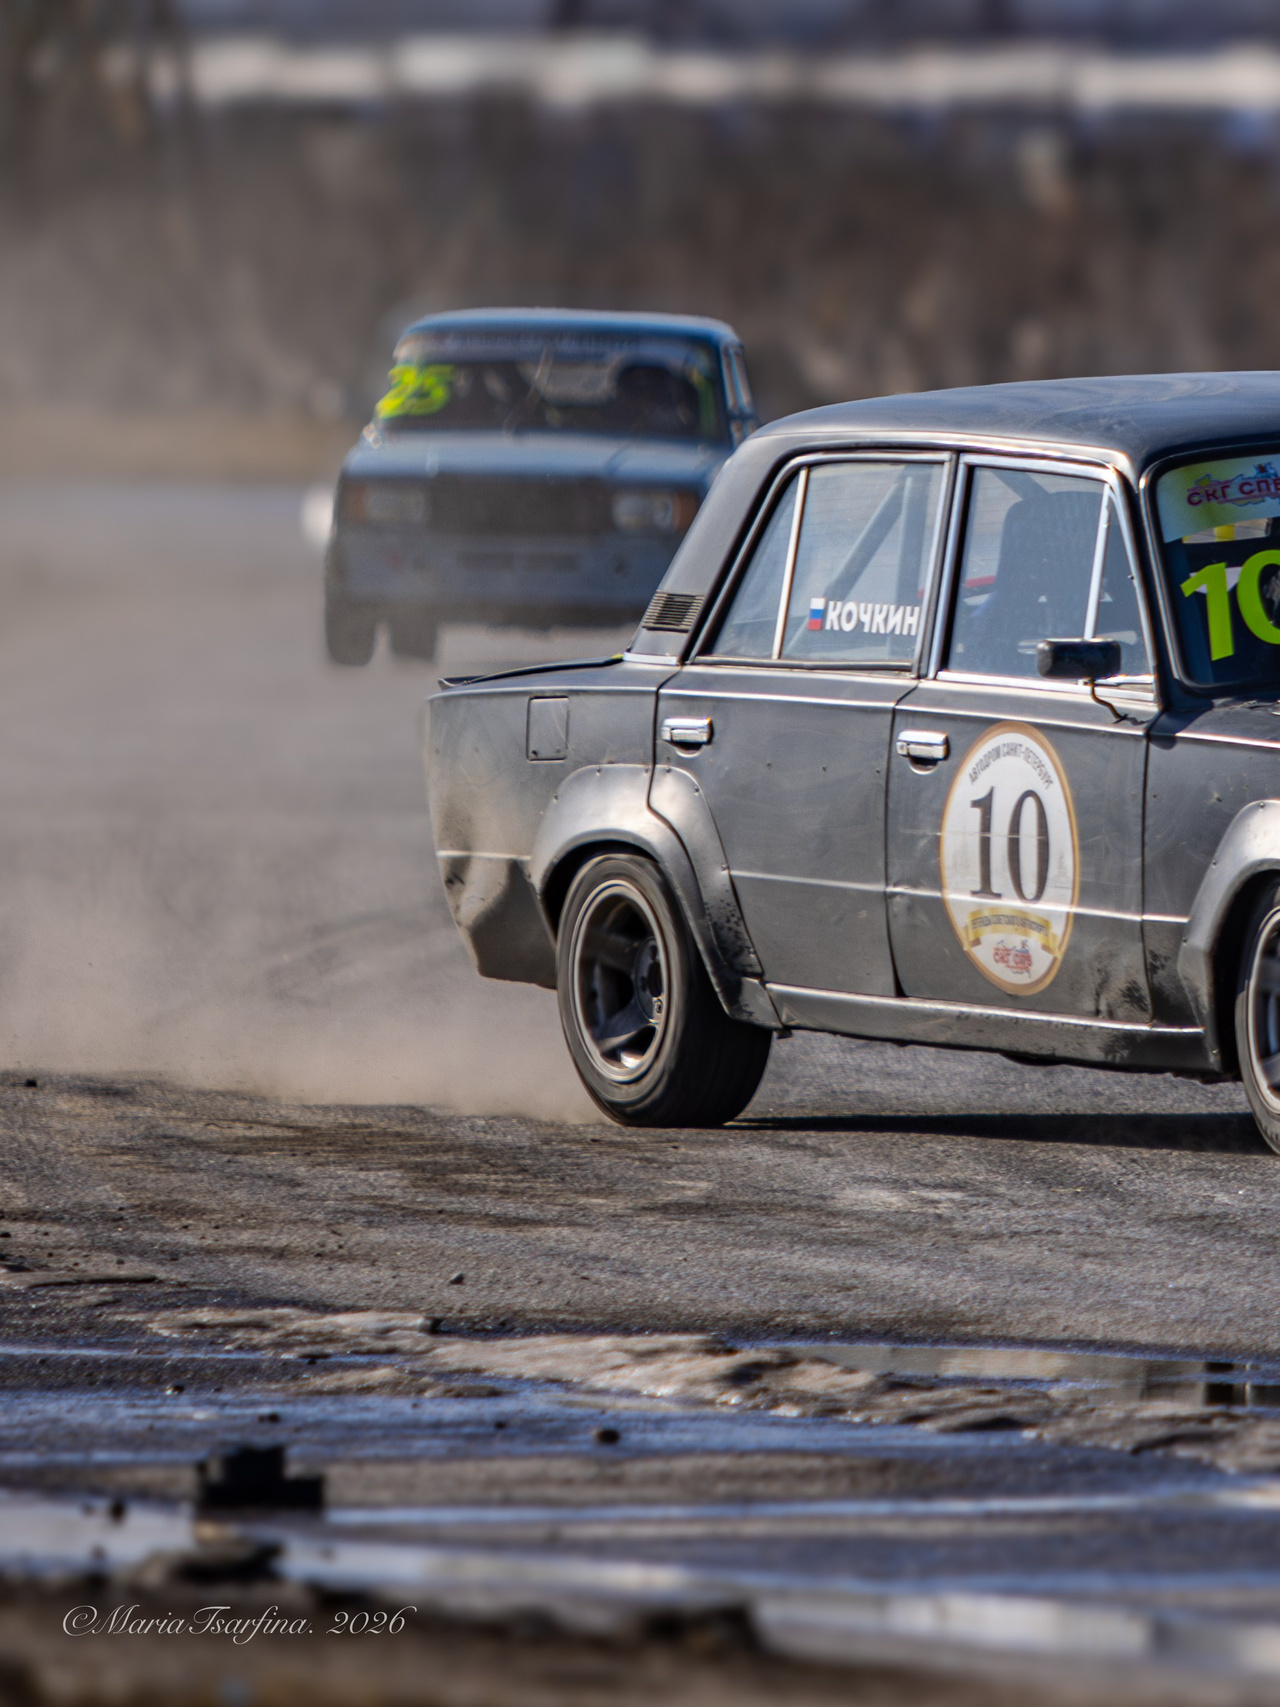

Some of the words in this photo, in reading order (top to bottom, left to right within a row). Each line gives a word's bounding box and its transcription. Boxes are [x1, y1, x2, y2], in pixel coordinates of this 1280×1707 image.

[1187, 484, 1231, 506] СКГ
[825, 600, 920, 636] КОЧКИН
[970, 786, 1050, 902] 10
